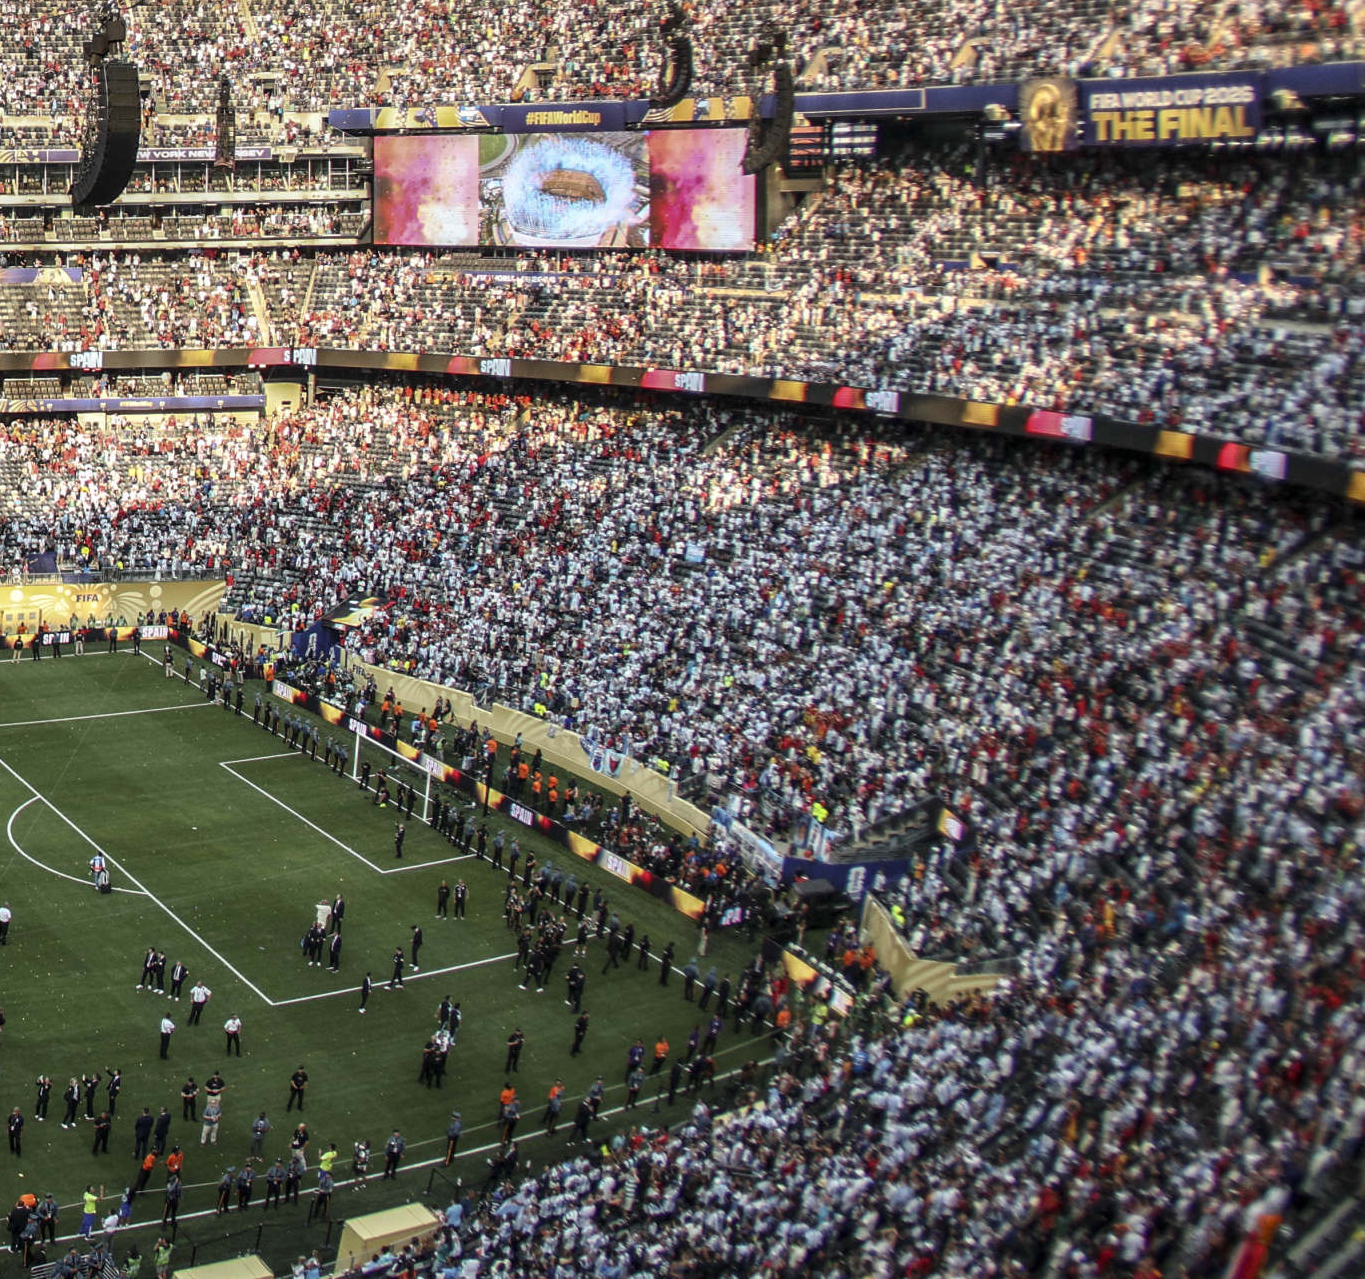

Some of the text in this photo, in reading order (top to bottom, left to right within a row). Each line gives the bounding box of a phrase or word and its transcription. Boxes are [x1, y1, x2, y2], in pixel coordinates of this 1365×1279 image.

[1090, 85, 1256, 109] FIFA WORLD CUP 2026
[526, 110, 601, 126] #FIFAWorldCup
[1091, 106, 1256, 141] THE FINAL
[152, 150, 187, 159] YORK
[188, 150, 216, 159] NEW
[70, 352, 103, 370] SPAIN
[480, 358, 511, 377] SPAIN
[76, 594, 99, 603] FIFA
[141, 626, 168, 639] SPAIN
